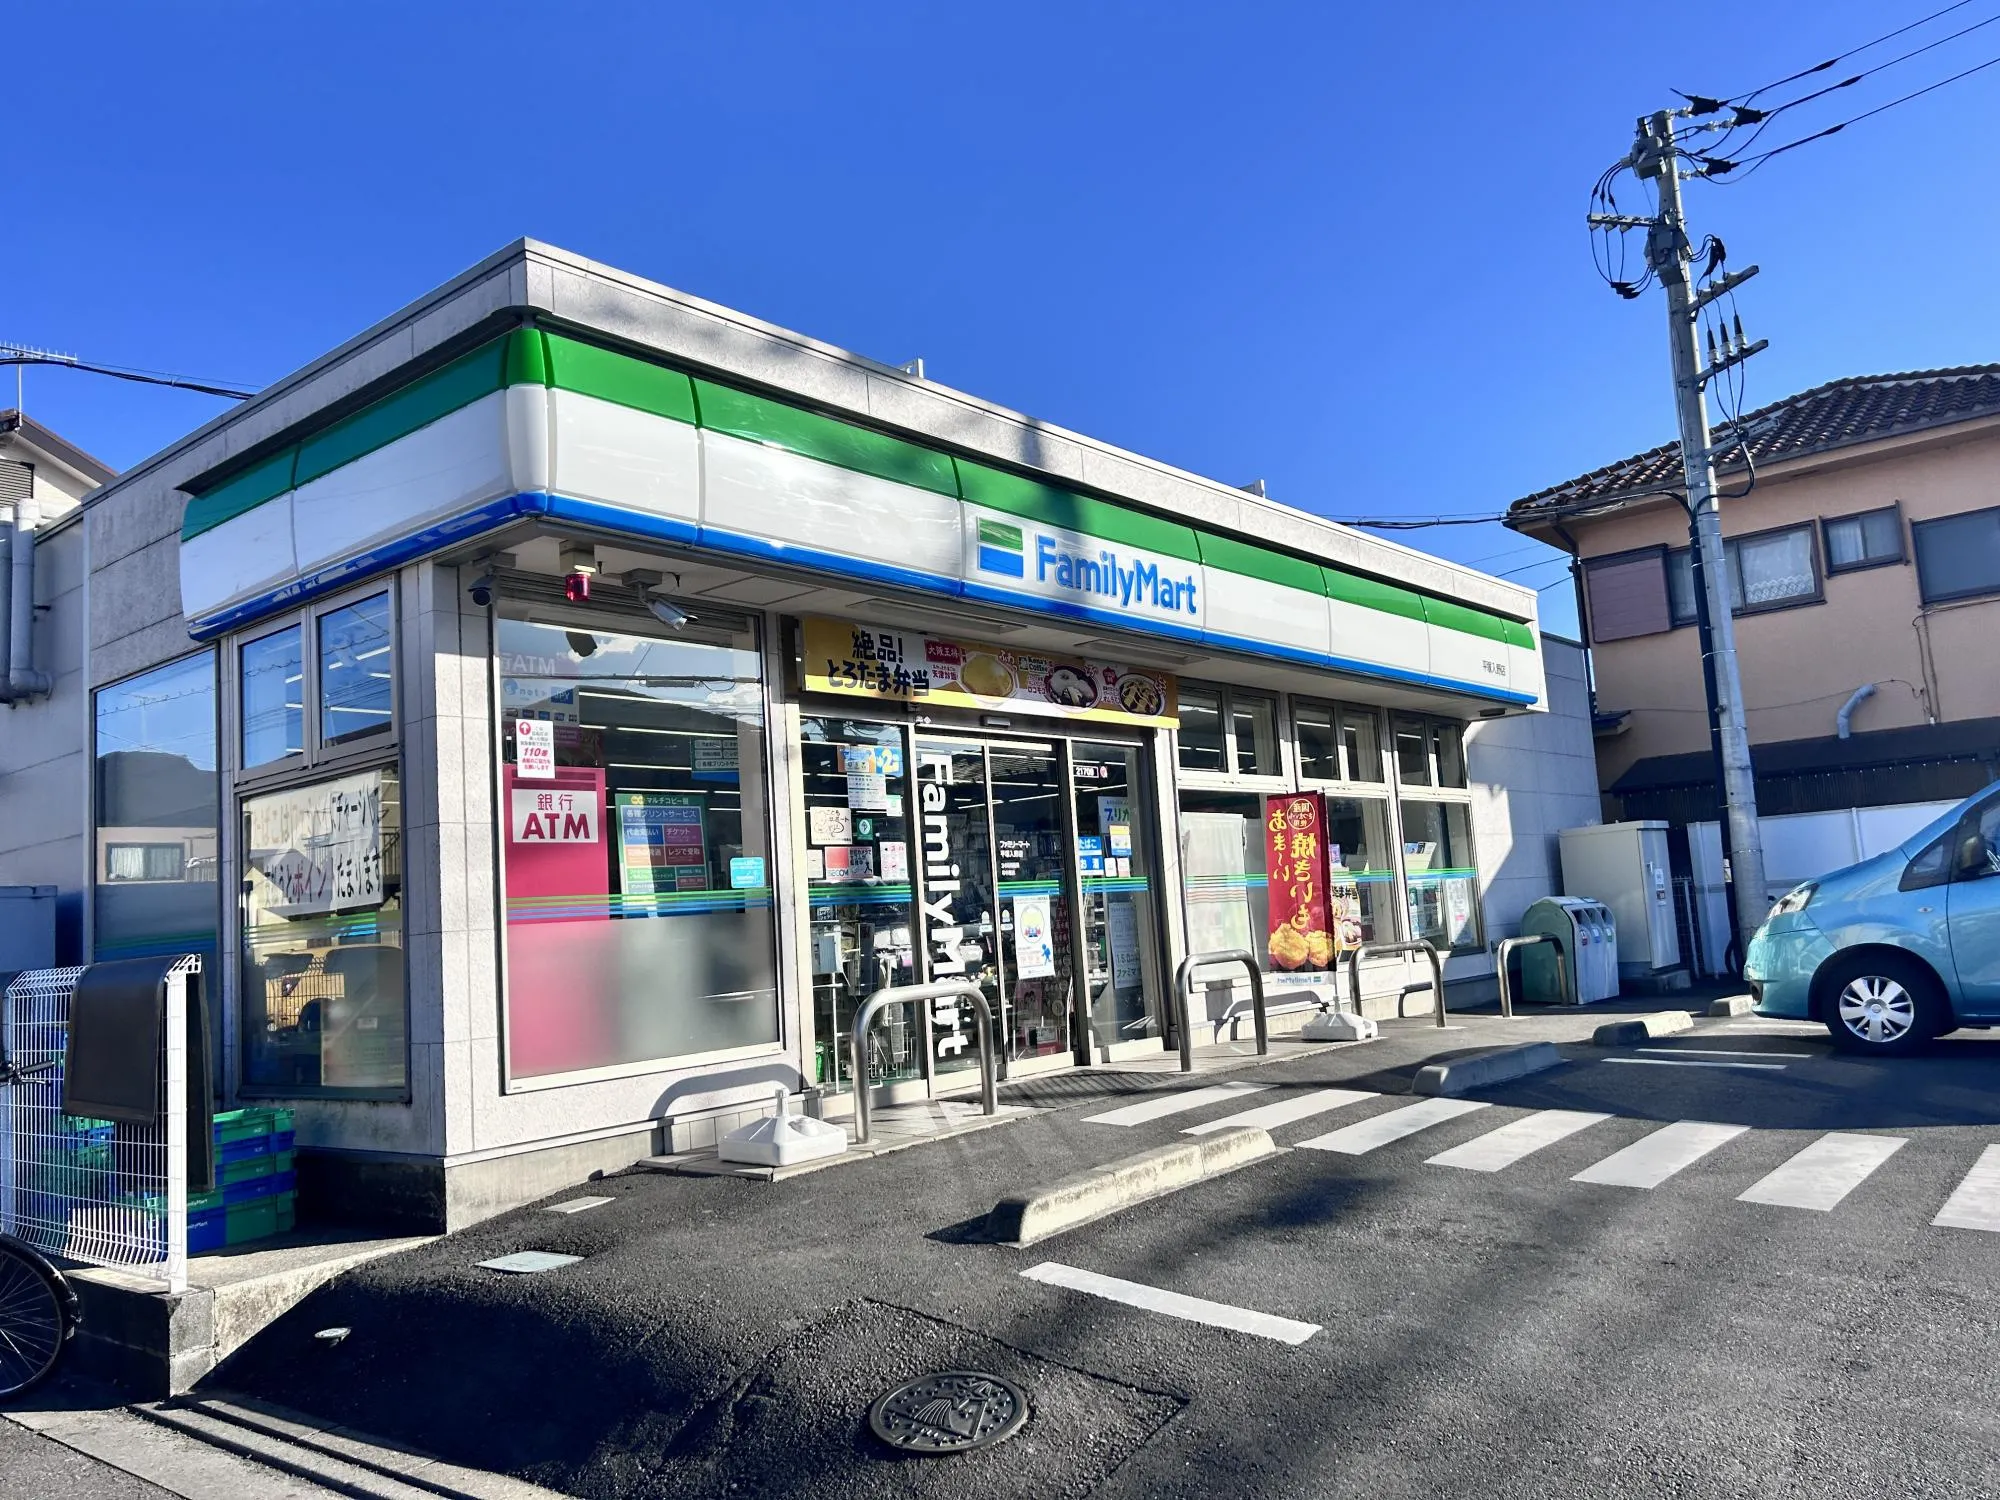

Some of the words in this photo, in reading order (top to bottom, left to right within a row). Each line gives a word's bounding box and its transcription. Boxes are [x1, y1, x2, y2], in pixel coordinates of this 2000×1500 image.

[1035, 532, 1197, 614] FamilyMart
[851, 629, 903, 663] 絶品!
[827, 659, 930, 697] とろたま弁当
[524, 747, 549, 757] 110番
[537, 793, 573, 811] 銀行
[626, 809, 697, 818] 各種プリントサービス
[522, 813, 590, 839] ATM
[666, 828, 690, 836] チケット
[1079, 838, 1097, 849] たばこ
